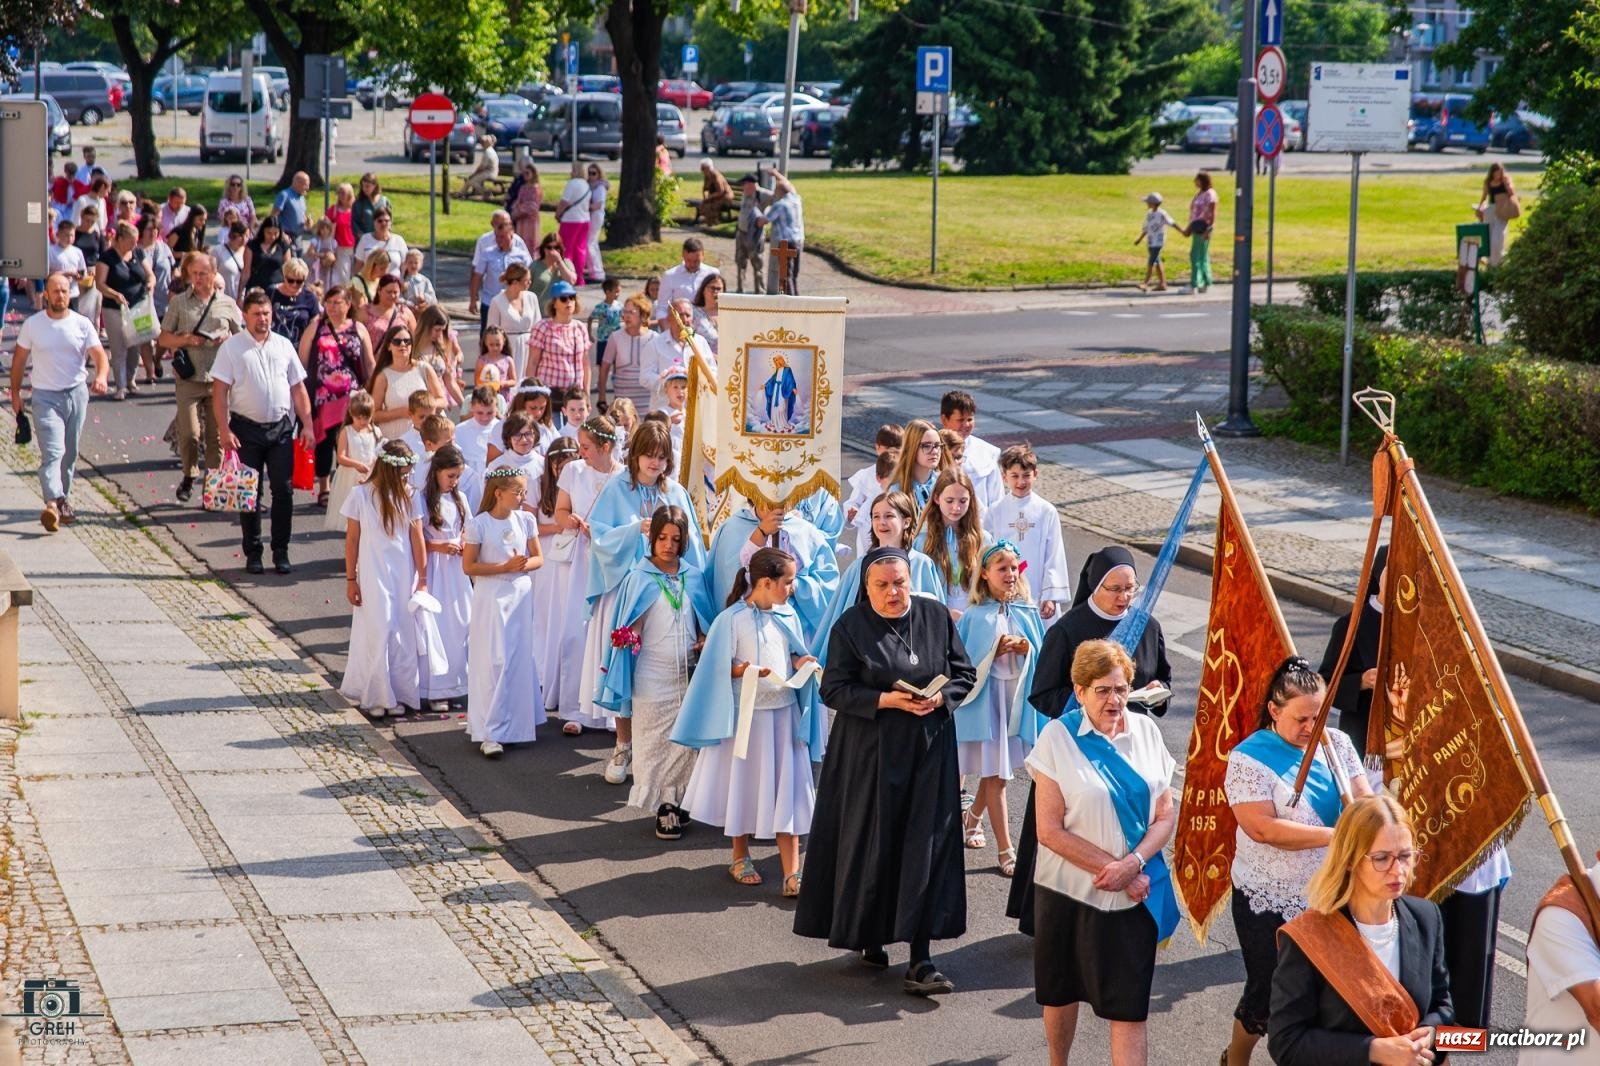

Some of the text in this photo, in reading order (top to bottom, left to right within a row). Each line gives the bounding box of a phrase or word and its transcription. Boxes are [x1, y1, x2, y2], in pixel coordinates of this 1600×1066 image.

[686, 47, 696, 61] P
[924, 52, 944, 87] P
[1260, 65, 1280, 87] 3,5t
[1432, 728, 1468, 765] PANNY
[1190, 815, 1217, 832] 1975
